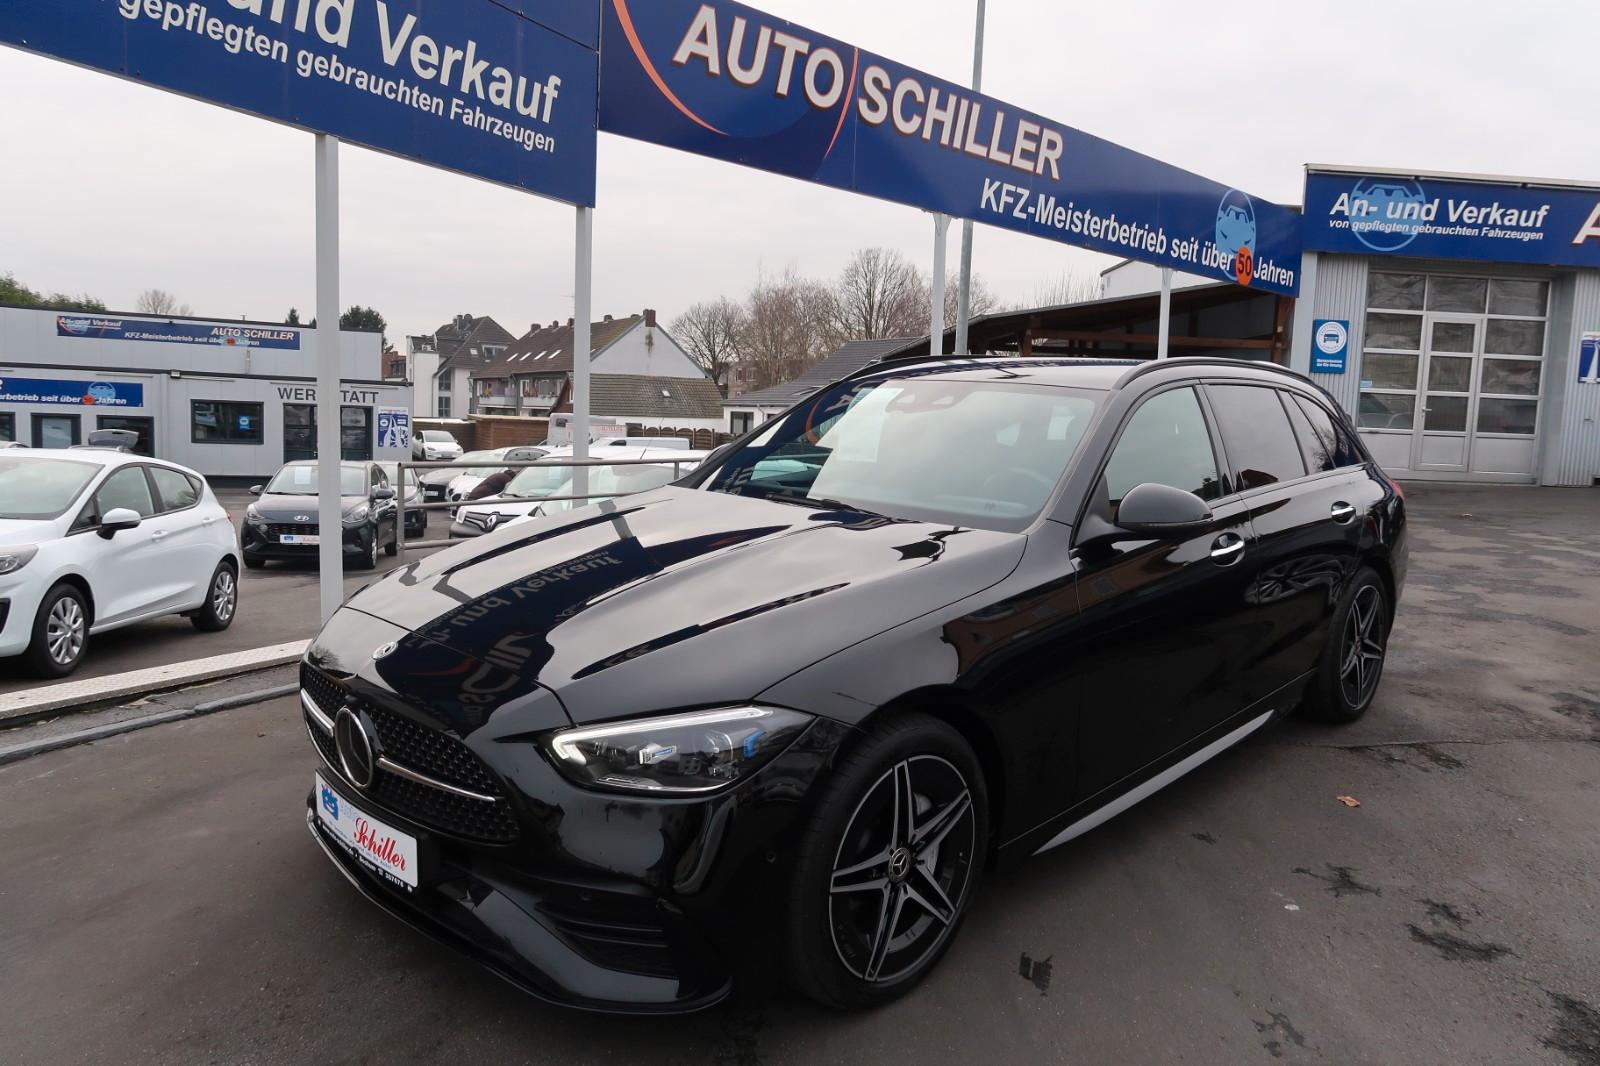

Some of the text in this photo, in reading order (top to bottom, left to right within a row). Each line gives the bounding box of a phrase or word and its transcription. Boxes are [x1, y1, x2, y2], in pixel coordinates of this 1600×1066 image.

[119, 0, 555, 152] gepflegten gebrauchten Fahrzeugen
[376, 0, 561, 123] Verkauf
[672, 4, 1063, 181] AUTO SCHILLER
[980, 178, 1294, 287] KFZ-Meisterbetrieb seit über 50 Jahren
[1329, 193, 1550, 228] An- und Verkauf
[1329, 220, 1543, 241] von gepflegten gebrauchten Fahrzeugen
[211, 328, 294, 341] AUTO SCHILLER
[41, 394, 58, 403] seit
[60, 394, 80, 403] über
[277, 387, 379, 404] WERTATT
[353, 817, 407, 871] Schiller
